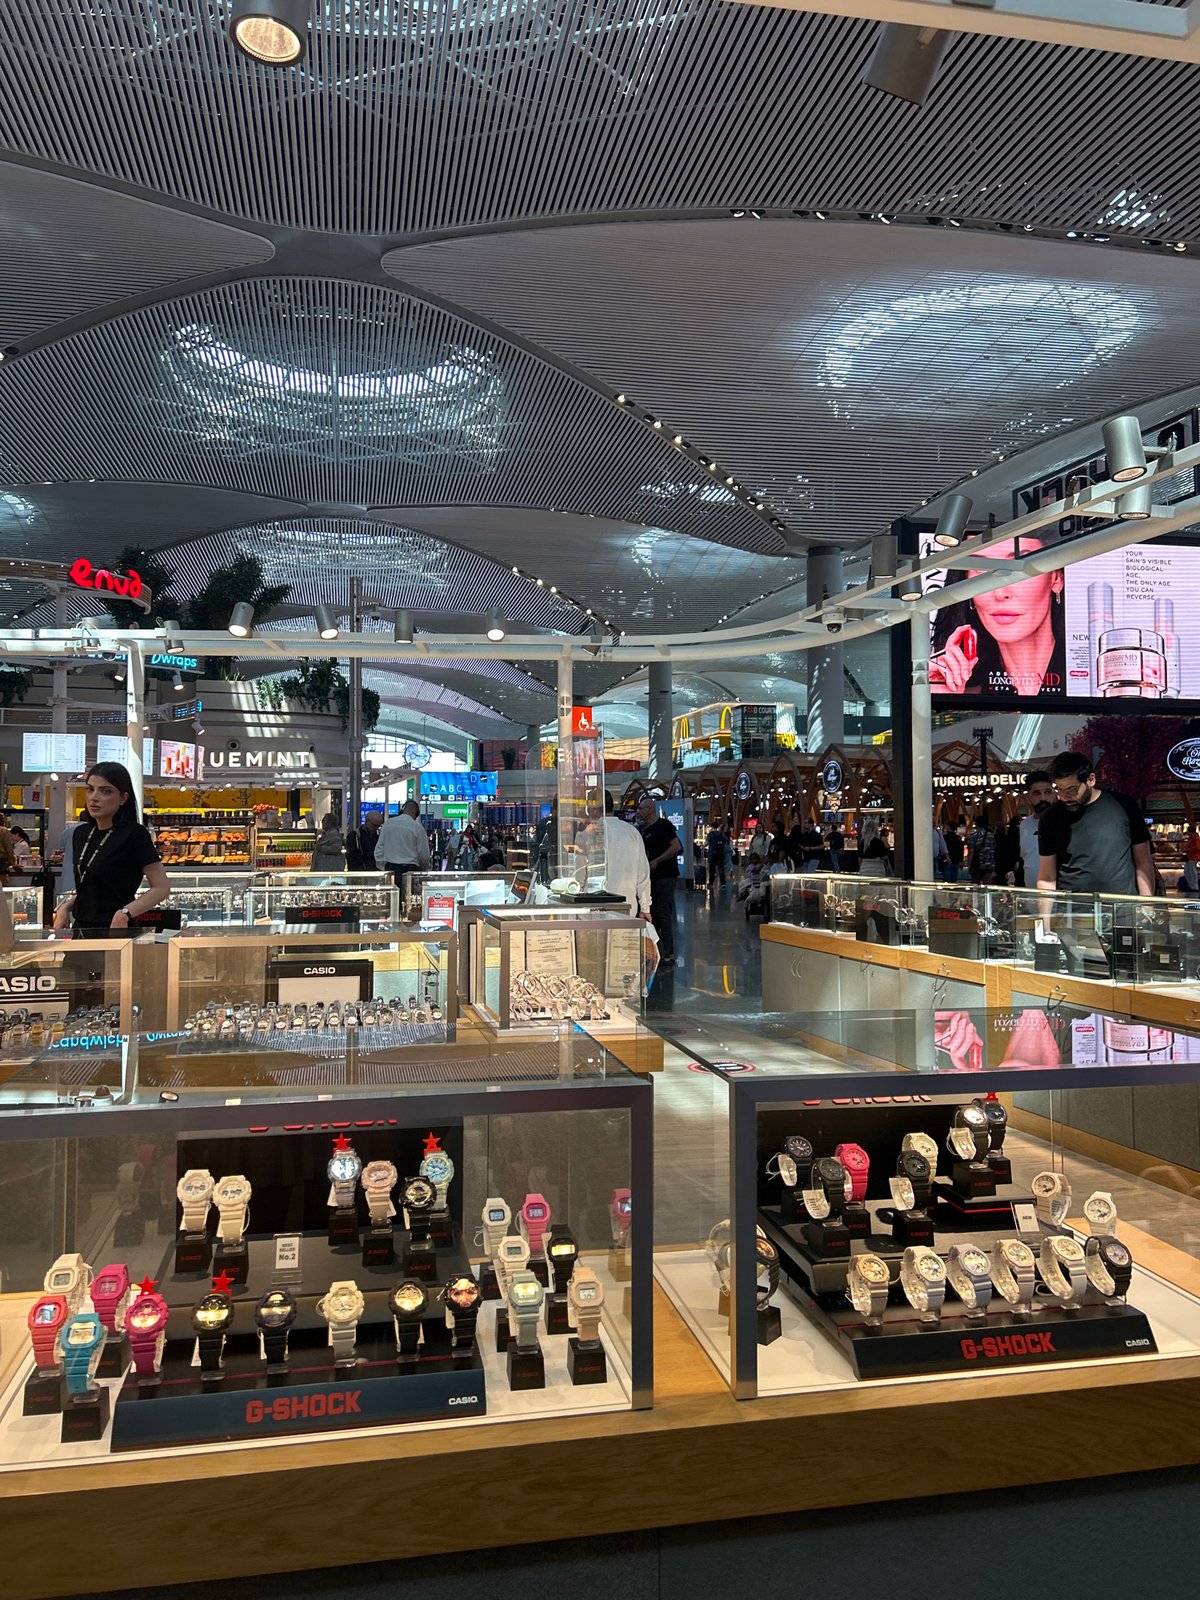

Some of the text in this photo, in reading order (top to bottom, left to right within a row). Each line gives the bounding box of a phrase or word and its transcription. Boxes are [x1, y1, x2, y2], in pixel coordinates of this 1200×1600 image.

[988, 672, 1061, 686] LONGEVITY MD
[440, 784, 447, 792] A
[448, 784, 455, 792] B
[933, 775, 987, 788] TURKISH
[302, 909, 342, 918] G-SHOCK
[303, 966, 336, 975] CASIO
[0, 975, 56, 993] ASIO
[961, 1332, 1150, 1359] G-SHOCK CASIO
[245, 1390, 478, 1423] G-SHOCK CASIO
